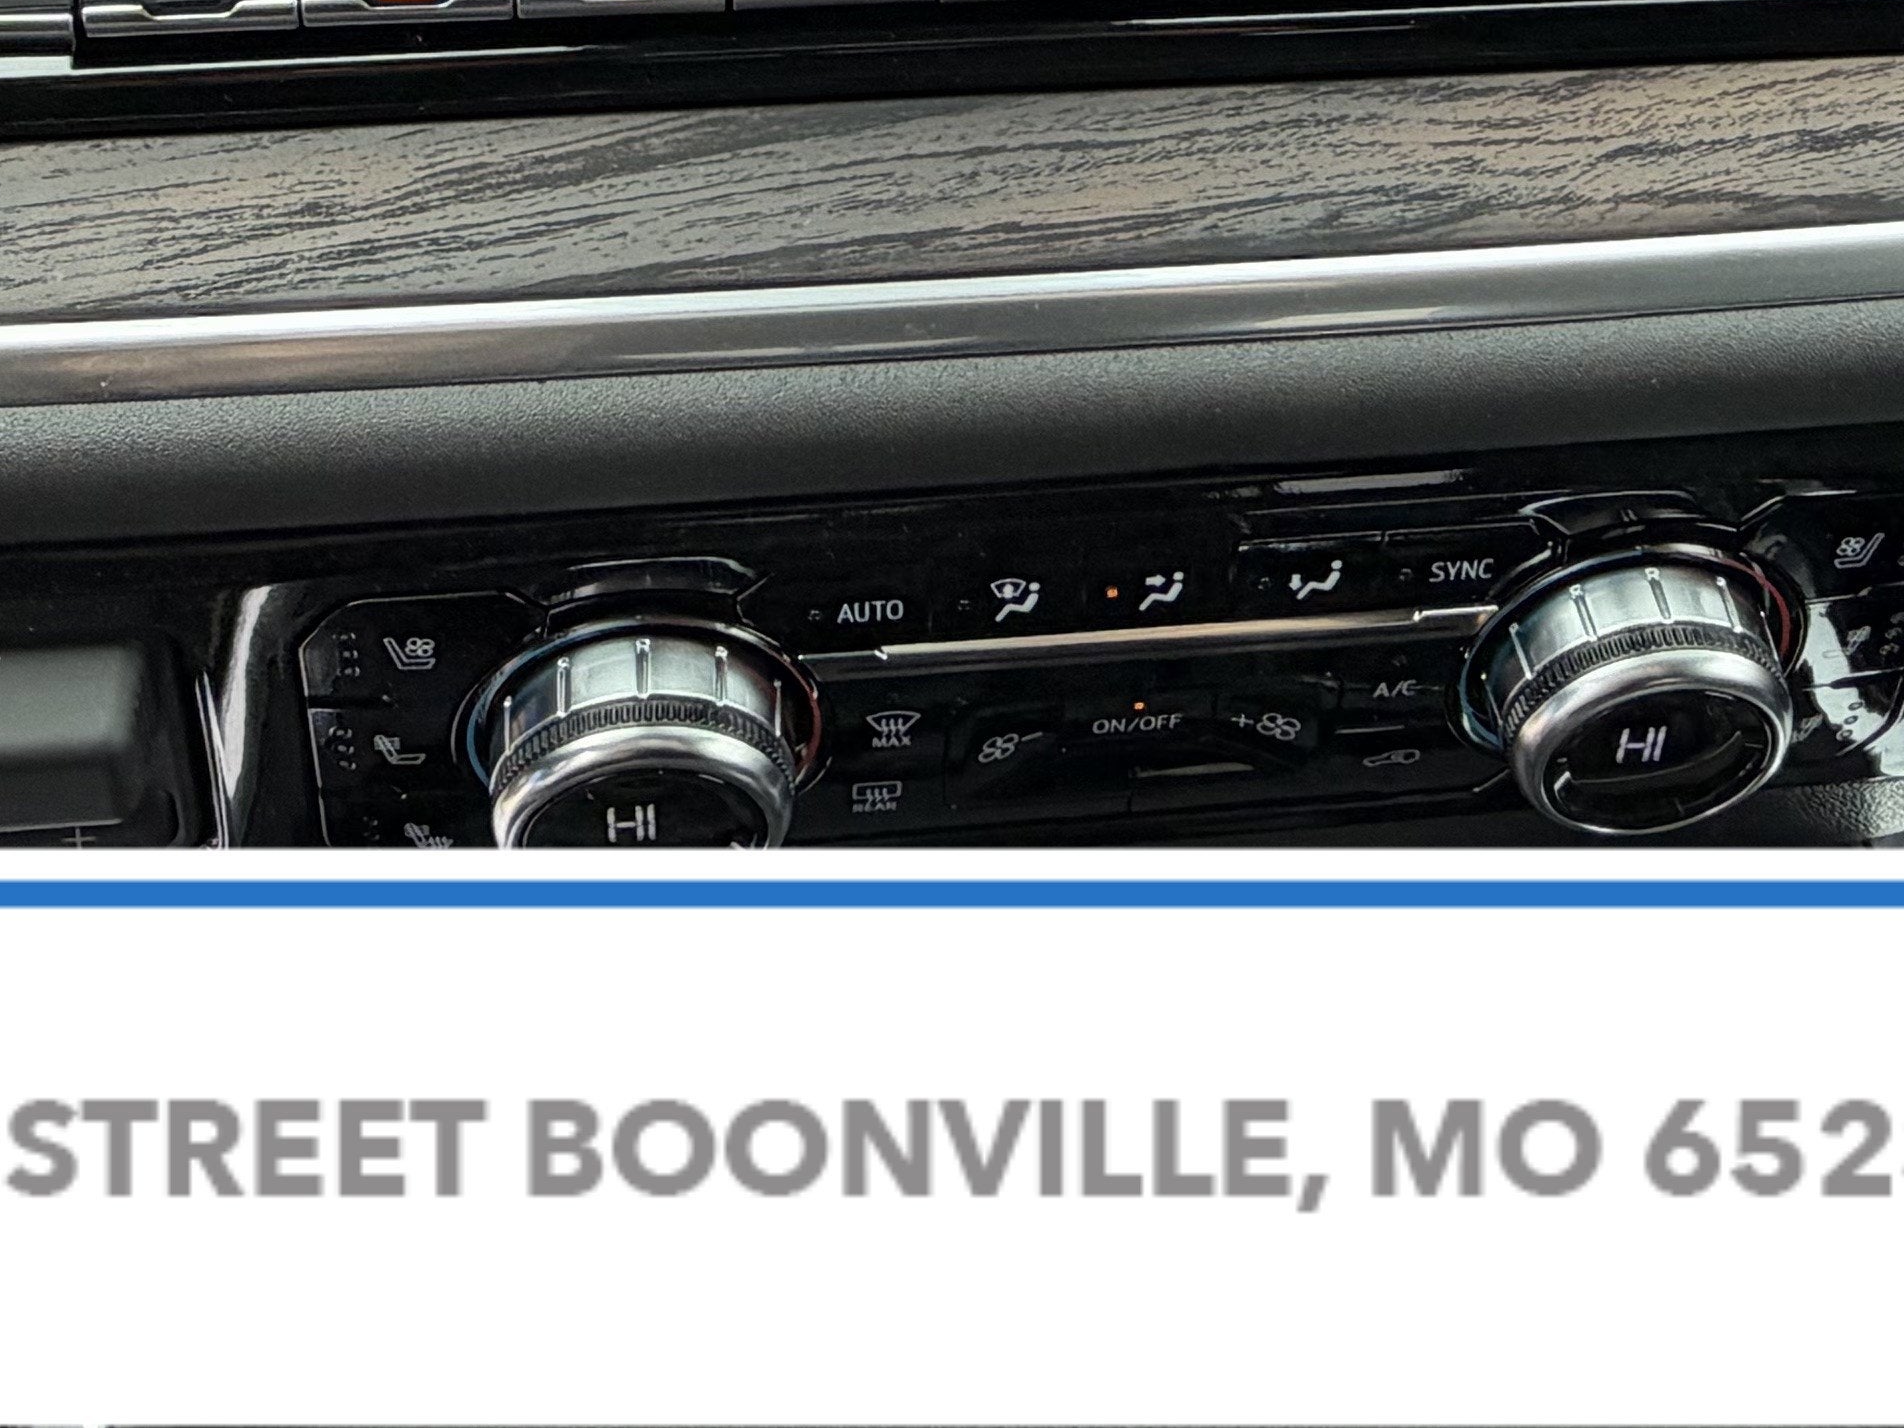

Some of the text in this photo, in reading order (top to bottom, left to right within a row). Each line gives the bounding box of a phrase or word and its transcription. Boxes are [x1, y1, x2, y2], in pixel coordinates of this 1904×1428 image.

[1428, 558, 1495, 583] SYNC
[837, 599, 904, 624] AUTO
[1373, 681, 1416, 699] A/C
[1092, 713, 1182, 734] ON/OFF
[1615, 725, 1668, 764] HI
[606, 804, 656, 843] HI
